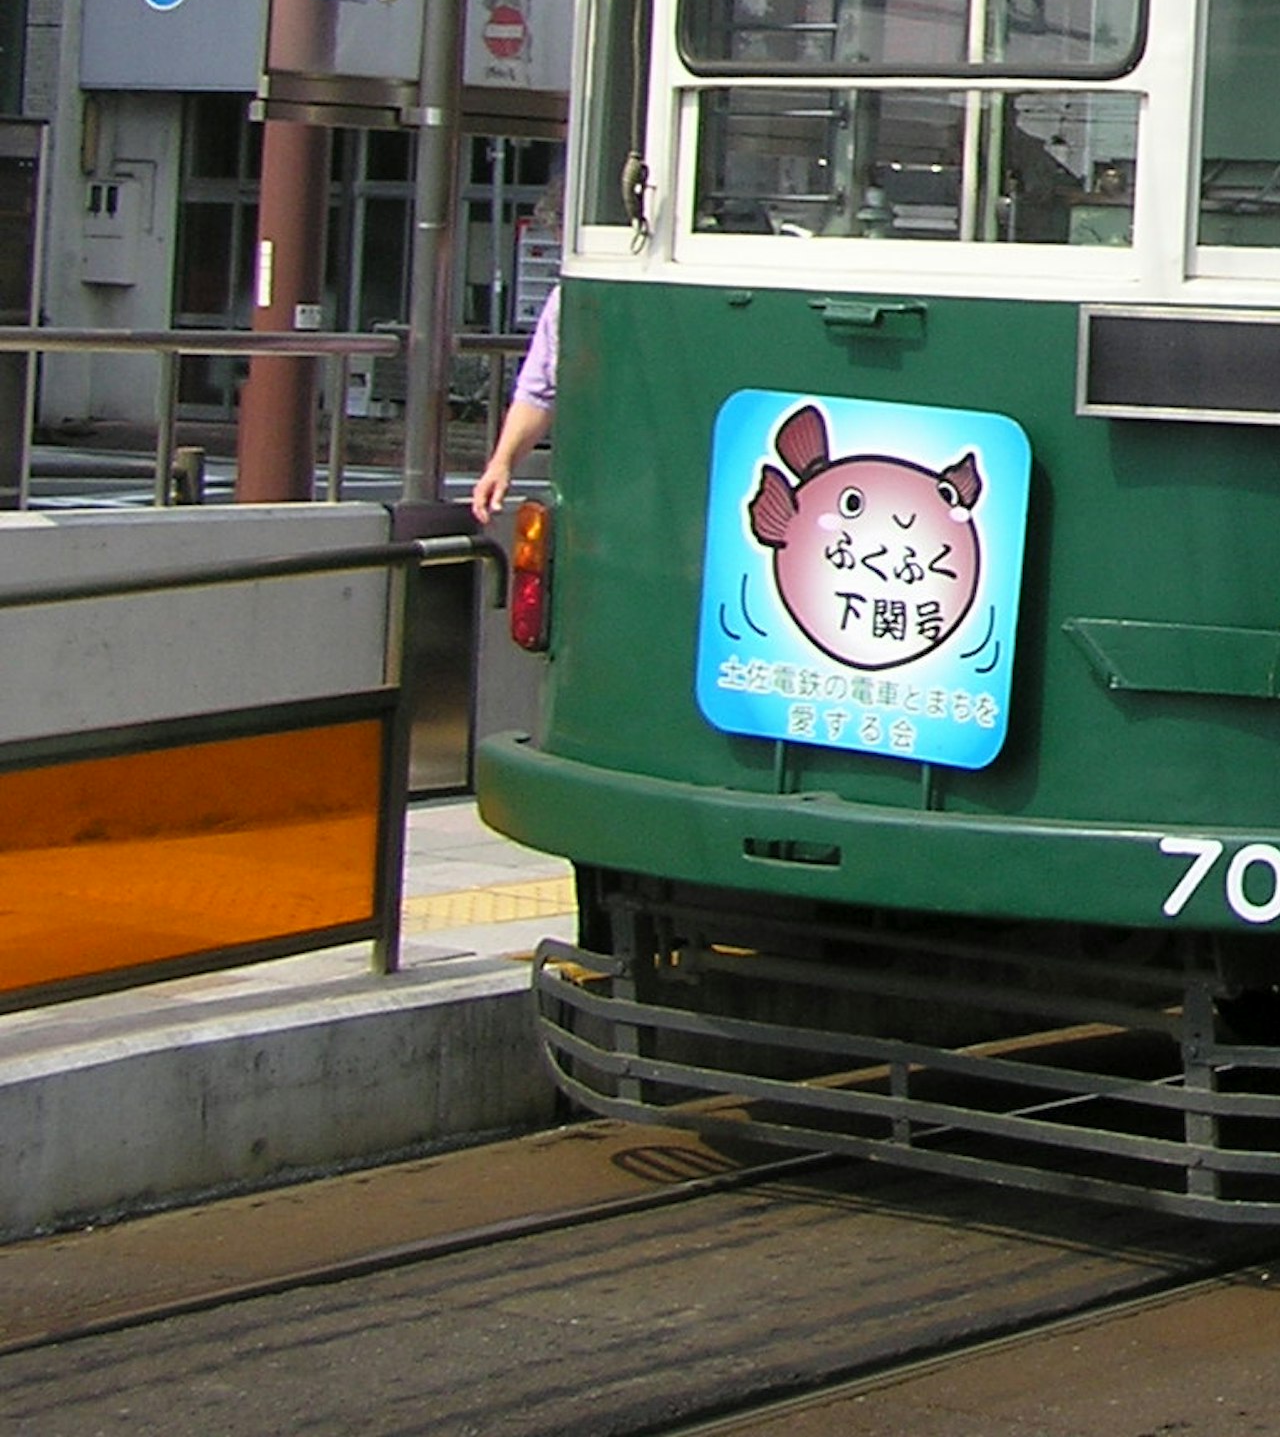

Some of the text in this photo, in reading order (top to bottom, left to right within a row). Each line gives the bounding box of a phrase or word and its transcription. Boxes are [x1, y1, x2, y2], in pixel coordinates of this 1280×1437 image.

[825, 530, 958, 585] ふくふく
[834, 590, 945, 641] 下関号
[718, 655, 999, 727] 土佐電鉄の電車とまちを
[788, 704, 915, 752] 愛する会
